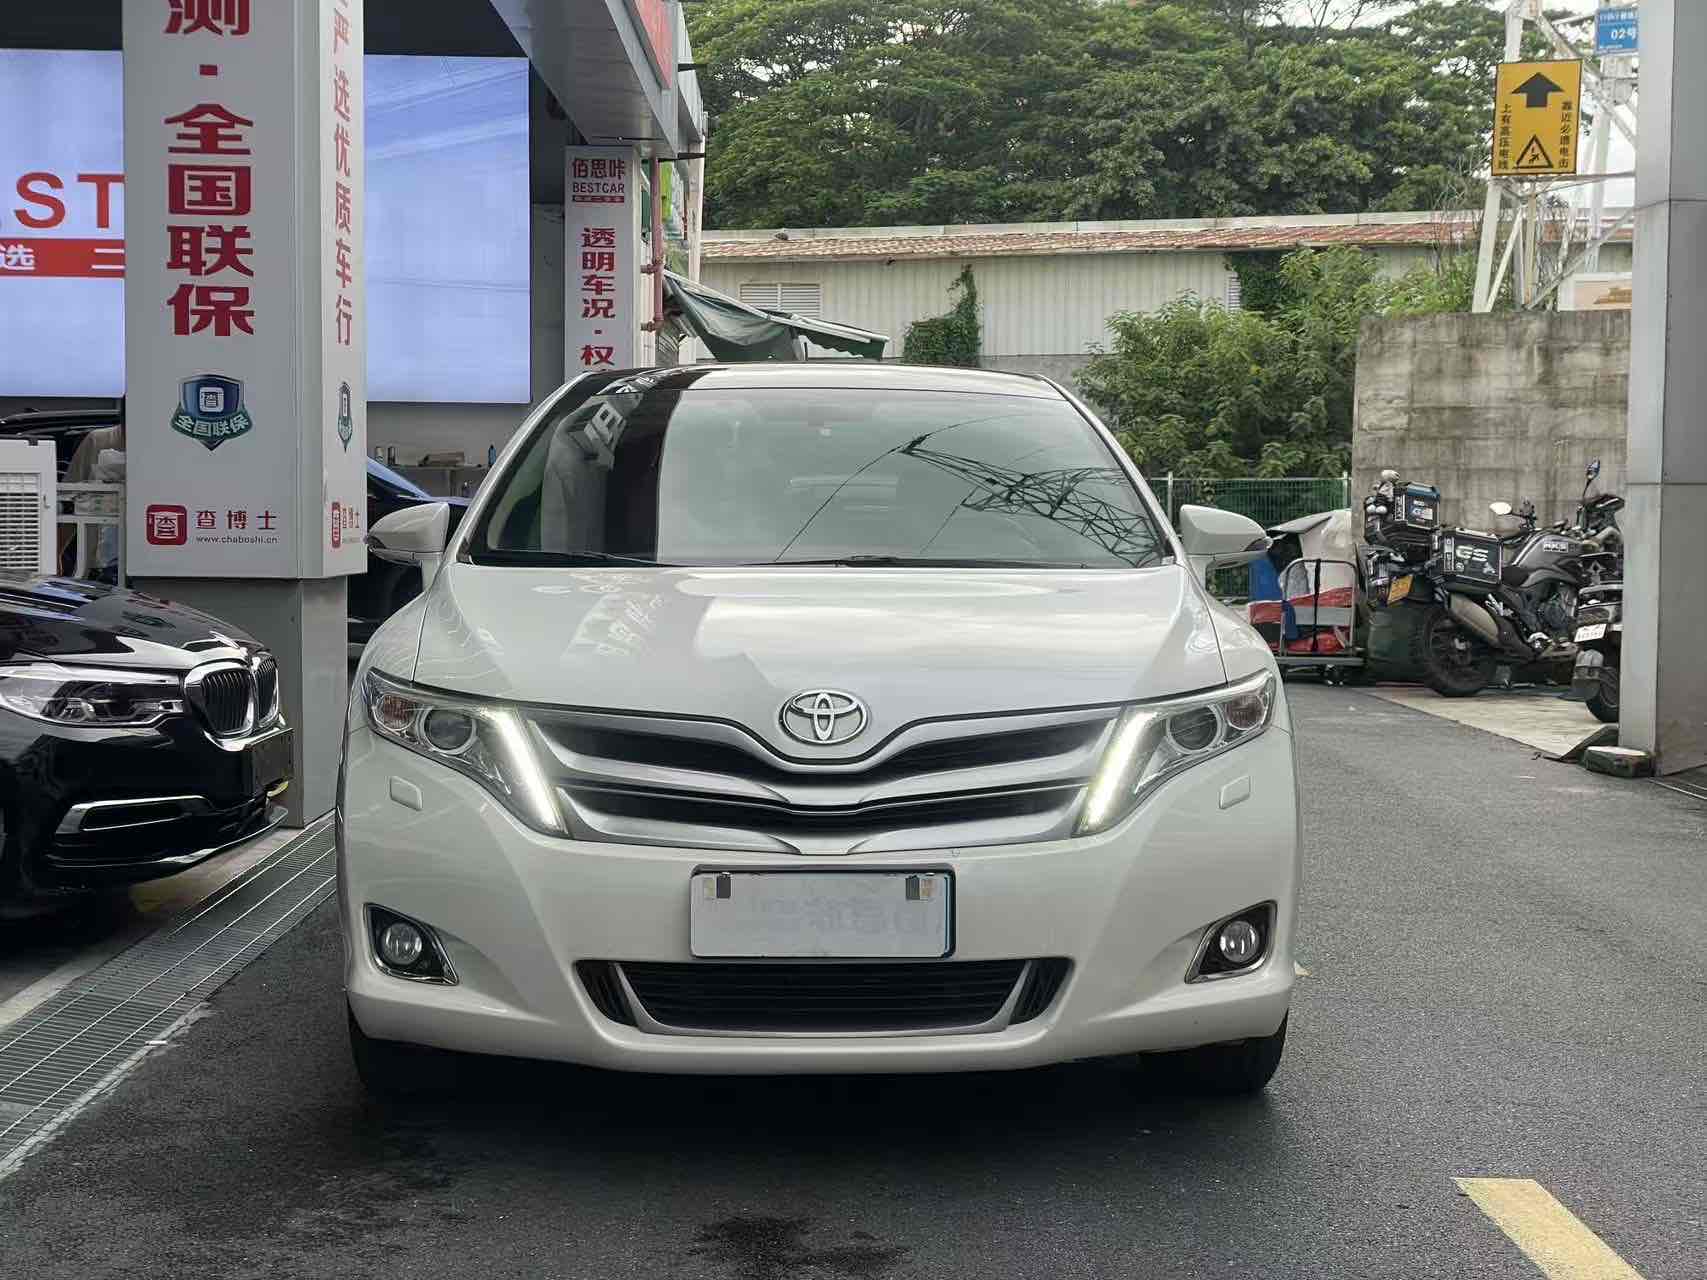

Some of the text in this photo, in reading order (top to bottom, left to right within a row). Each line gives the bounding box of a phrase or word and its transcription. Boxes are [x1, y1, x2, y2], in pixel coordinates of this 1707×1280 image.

[572, 158, 625, 180] 佰思咔
[572, 182, 625, 194] BESTCAR
[174, 413, 249, 438] 全国联保
[195, 509, 278, 531] 查博士
[195, 535, 279, 545] www.chaboshi.cn
[1455, 544, 1489, 562] GS
